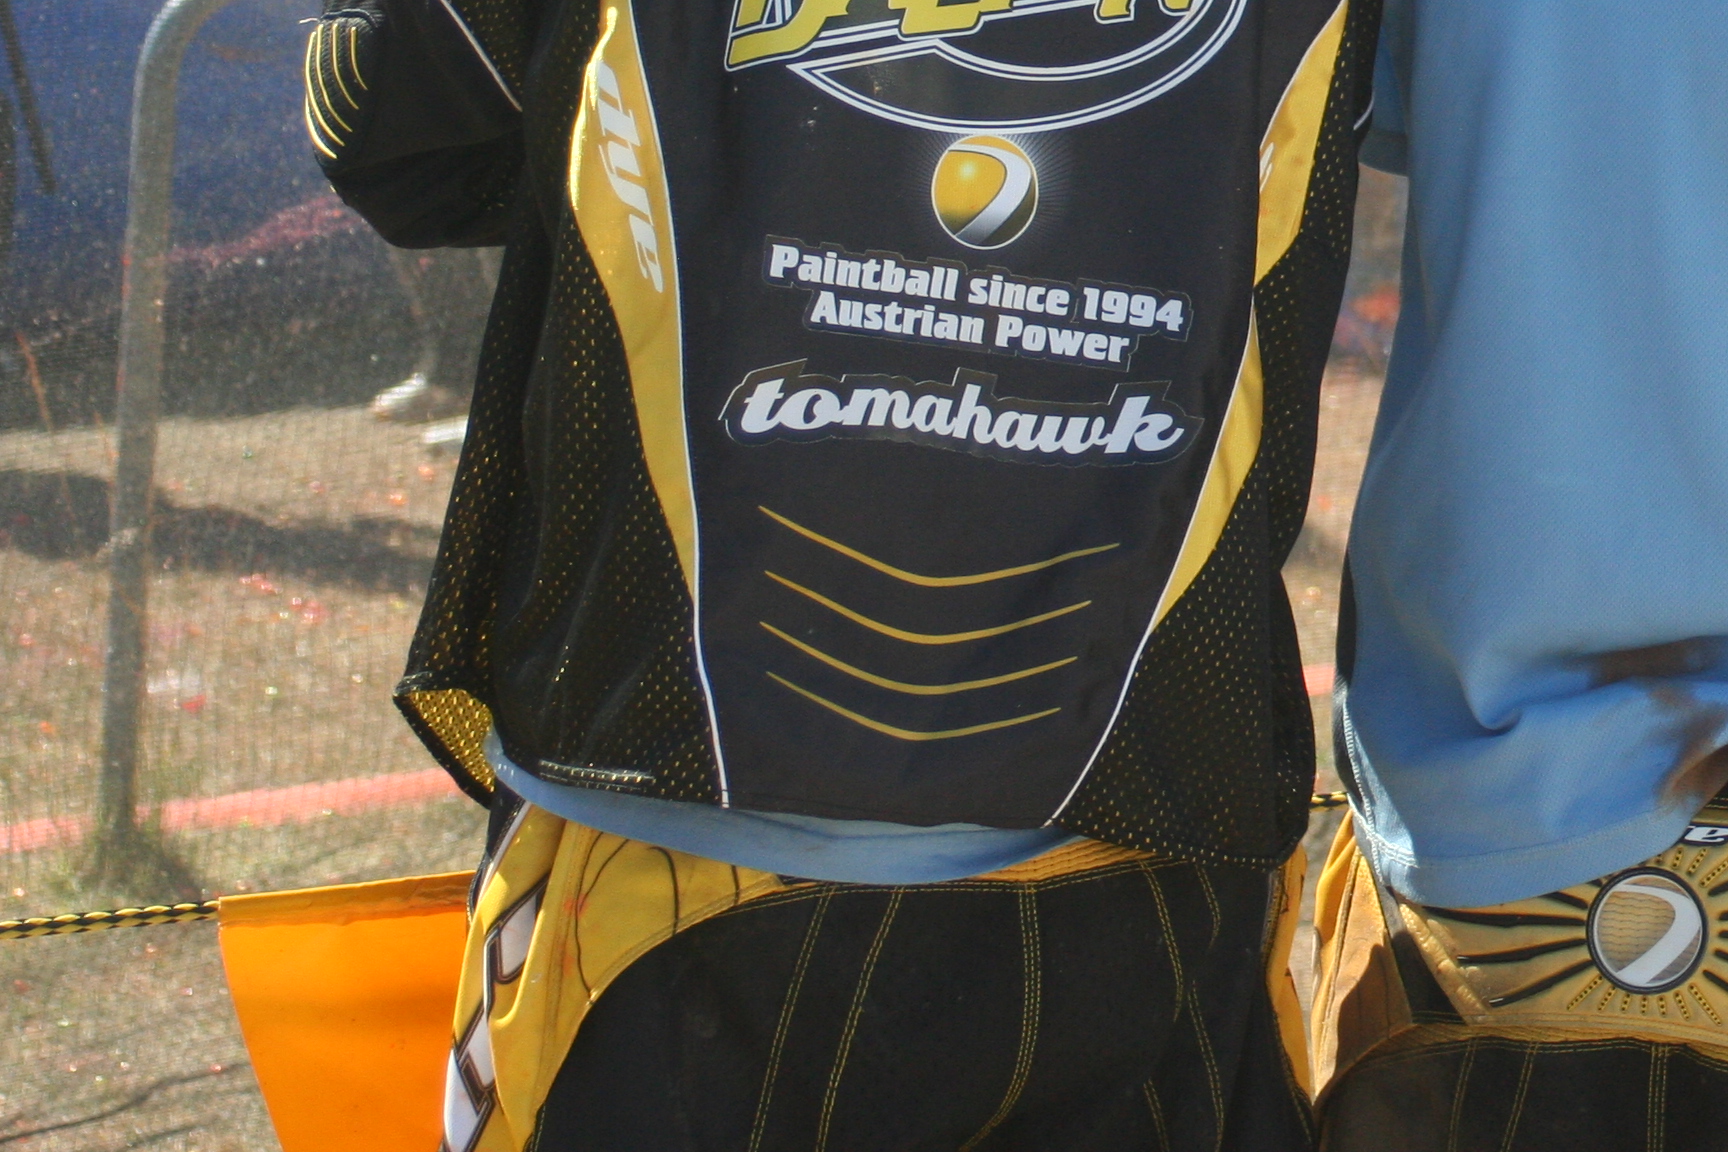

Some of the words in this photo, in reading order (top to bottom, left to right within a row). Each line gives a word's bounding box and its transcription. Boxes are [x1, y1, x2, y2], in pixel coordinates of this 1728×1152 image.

[769, 243, 958, 302] Paintball
[969, 273, 1069, 318] since
[1082, 285, 1185, 332] 1994
[810, 291, 983, 346] Austrian
[995, 322, 1131, 363] Power
[740, 375, 1187, 454] tomahawk
